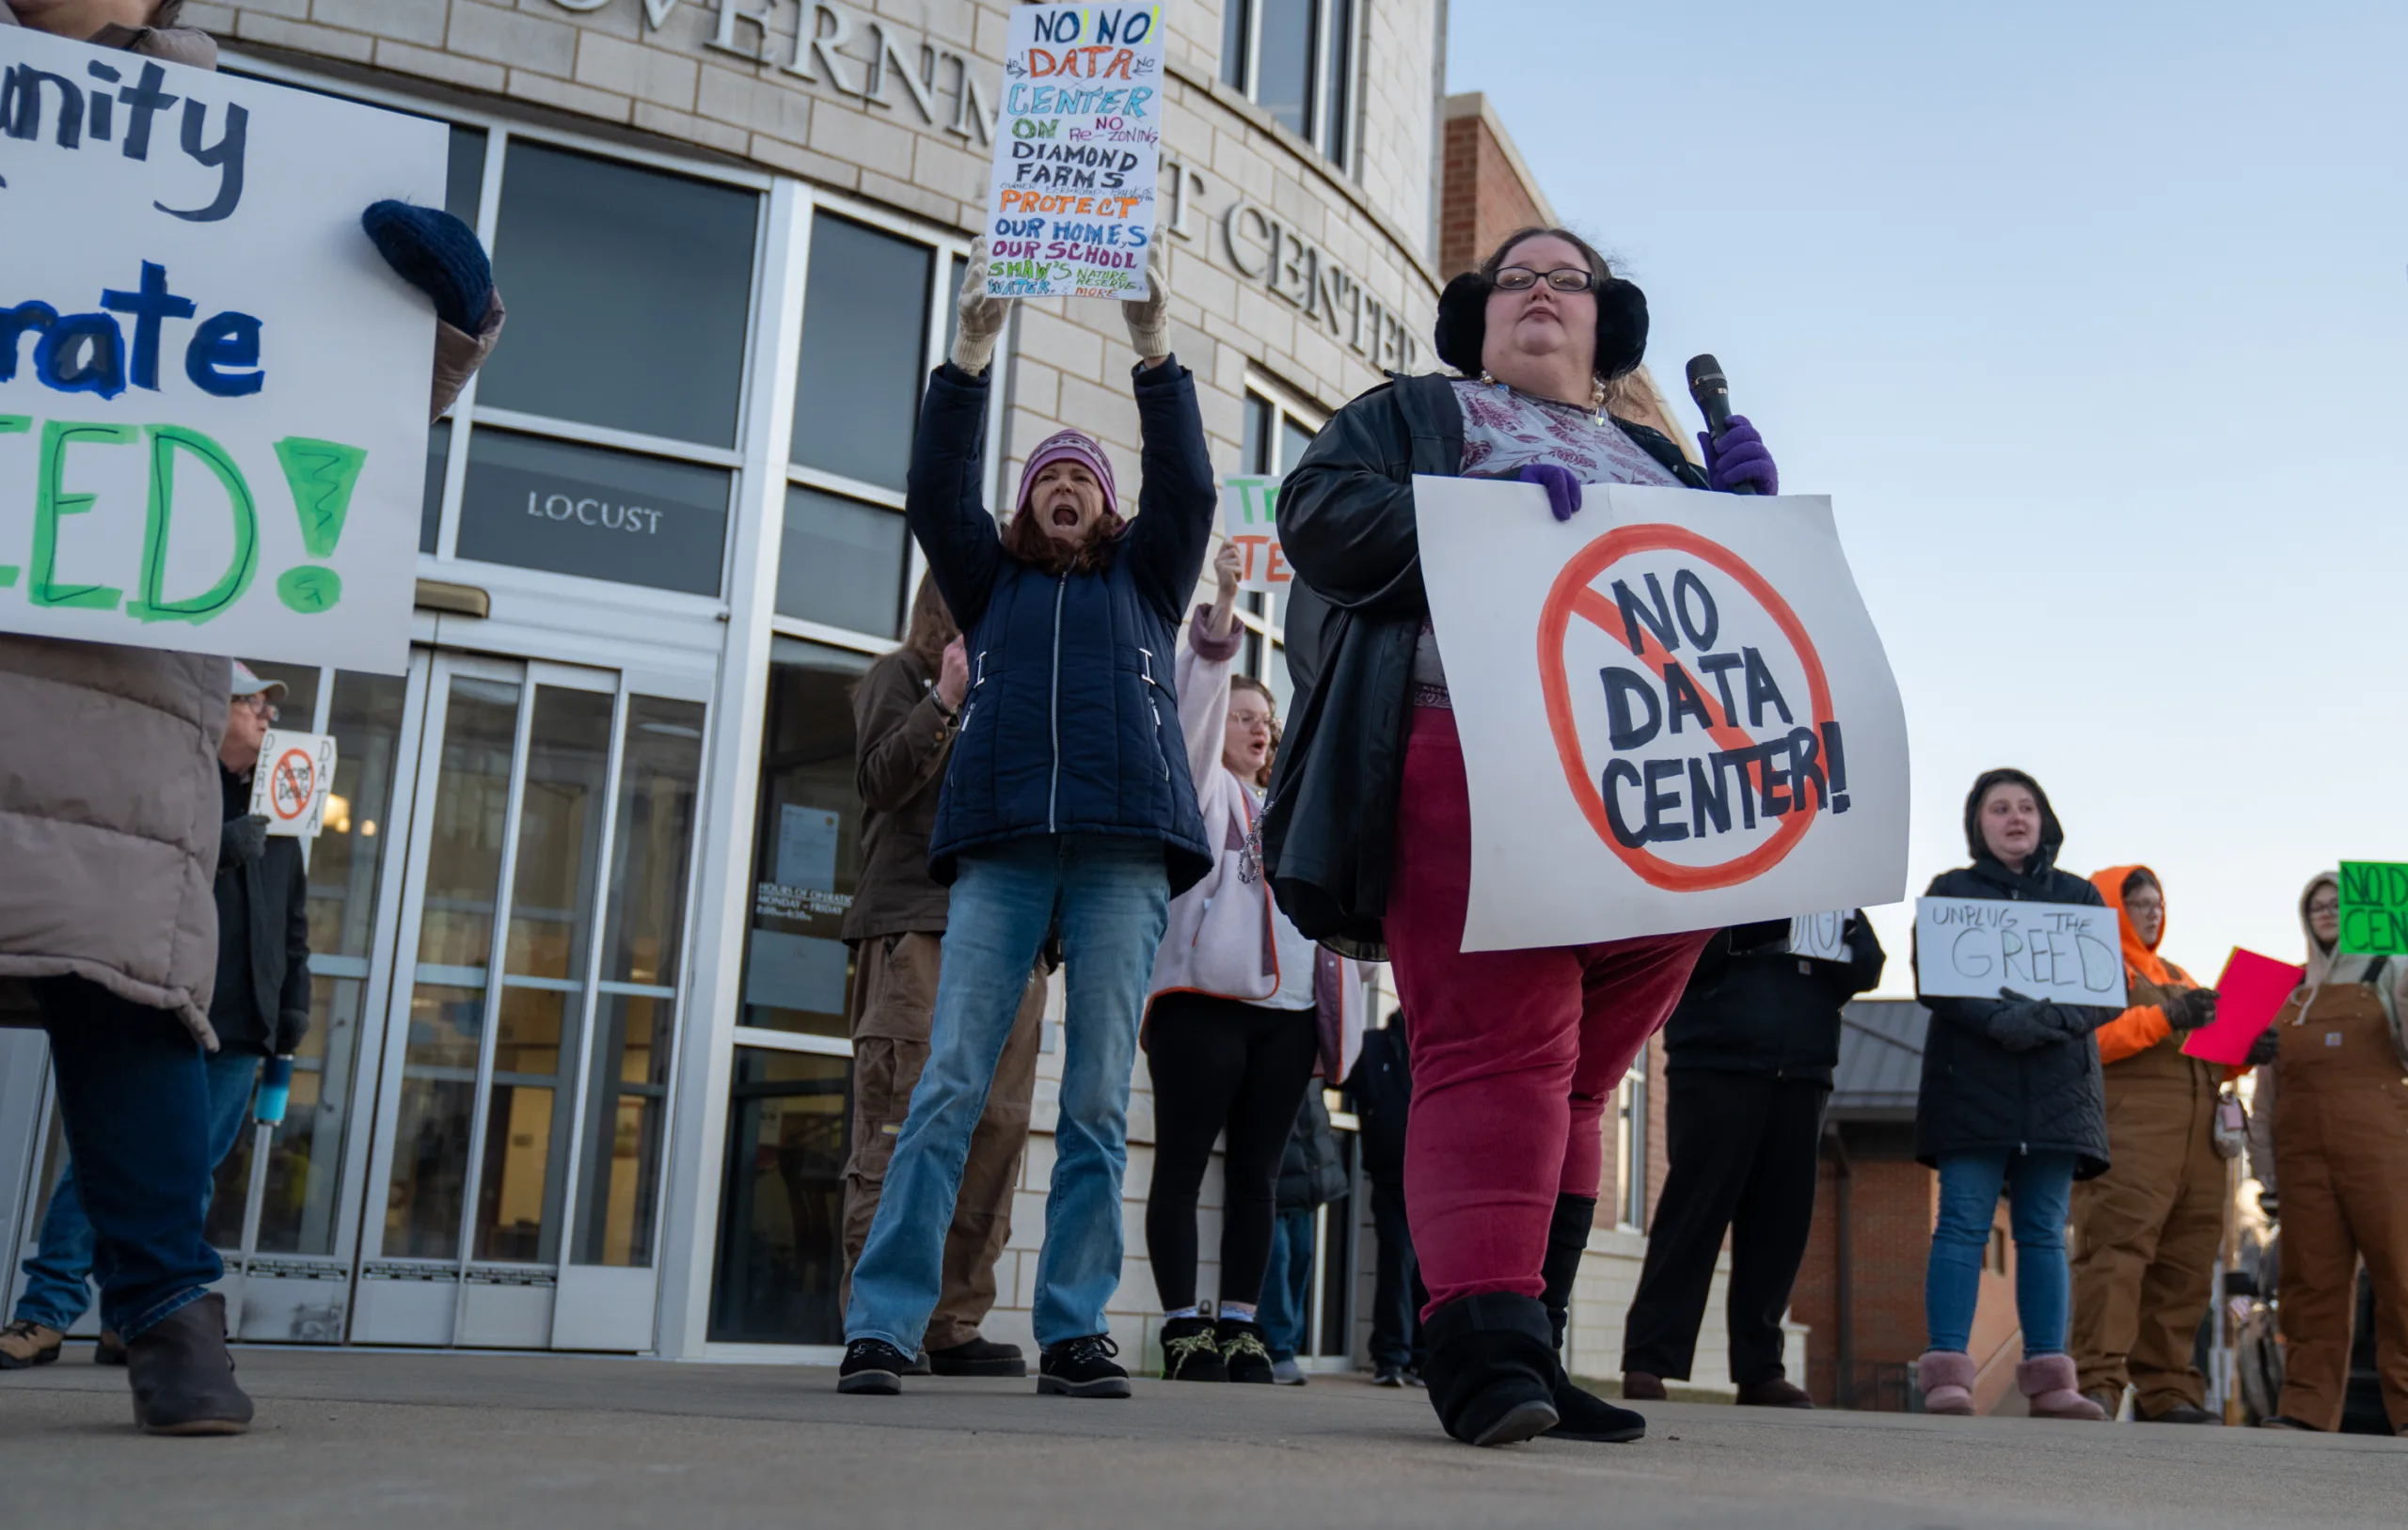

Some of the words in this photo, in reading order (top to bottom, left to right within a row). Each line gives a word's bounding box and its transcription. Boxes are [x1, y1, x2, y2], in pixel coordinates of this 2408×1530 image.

[1028, 45, 1134, 80] DATA
[1007, 82, 1153, 119] CENTER
[1011, 118, 1060, 140] ON
[1095, 116, 1124, 130] NO
[1012, 141, 1137, 173] DIAMOND
[1016, 162, 1124, 189] FARMS
[1000, 189, 1139, 219] PROTECT
[995, 217, 1046, 239] OUR
[991, 240, 1041, 260] OUR
[1045, 241, 1138, 269] SCHOOL
[988, 260, 1072, 280] SHAW'S
[1076, 267, 1130, 281] NATURE
[1075, 286, 1118, 298] MORE
[528, 491, 663, 534] LOCUST
[1610, 568, 1719, 656] NO
[1599, 646, 1794, 750] DATA
[1601, 720, 1850, 849] CENTER!
[2342, 865, 2383, 905] NO
[757, 894, 801, 910] MONDAY
[810, 901, 843, 916] FRIDAY
[1933, 906, 2018, 928] UNPLUG
[2043, 912, 2093, 934] THE
[1952, 927, 2115, 993] GREED
